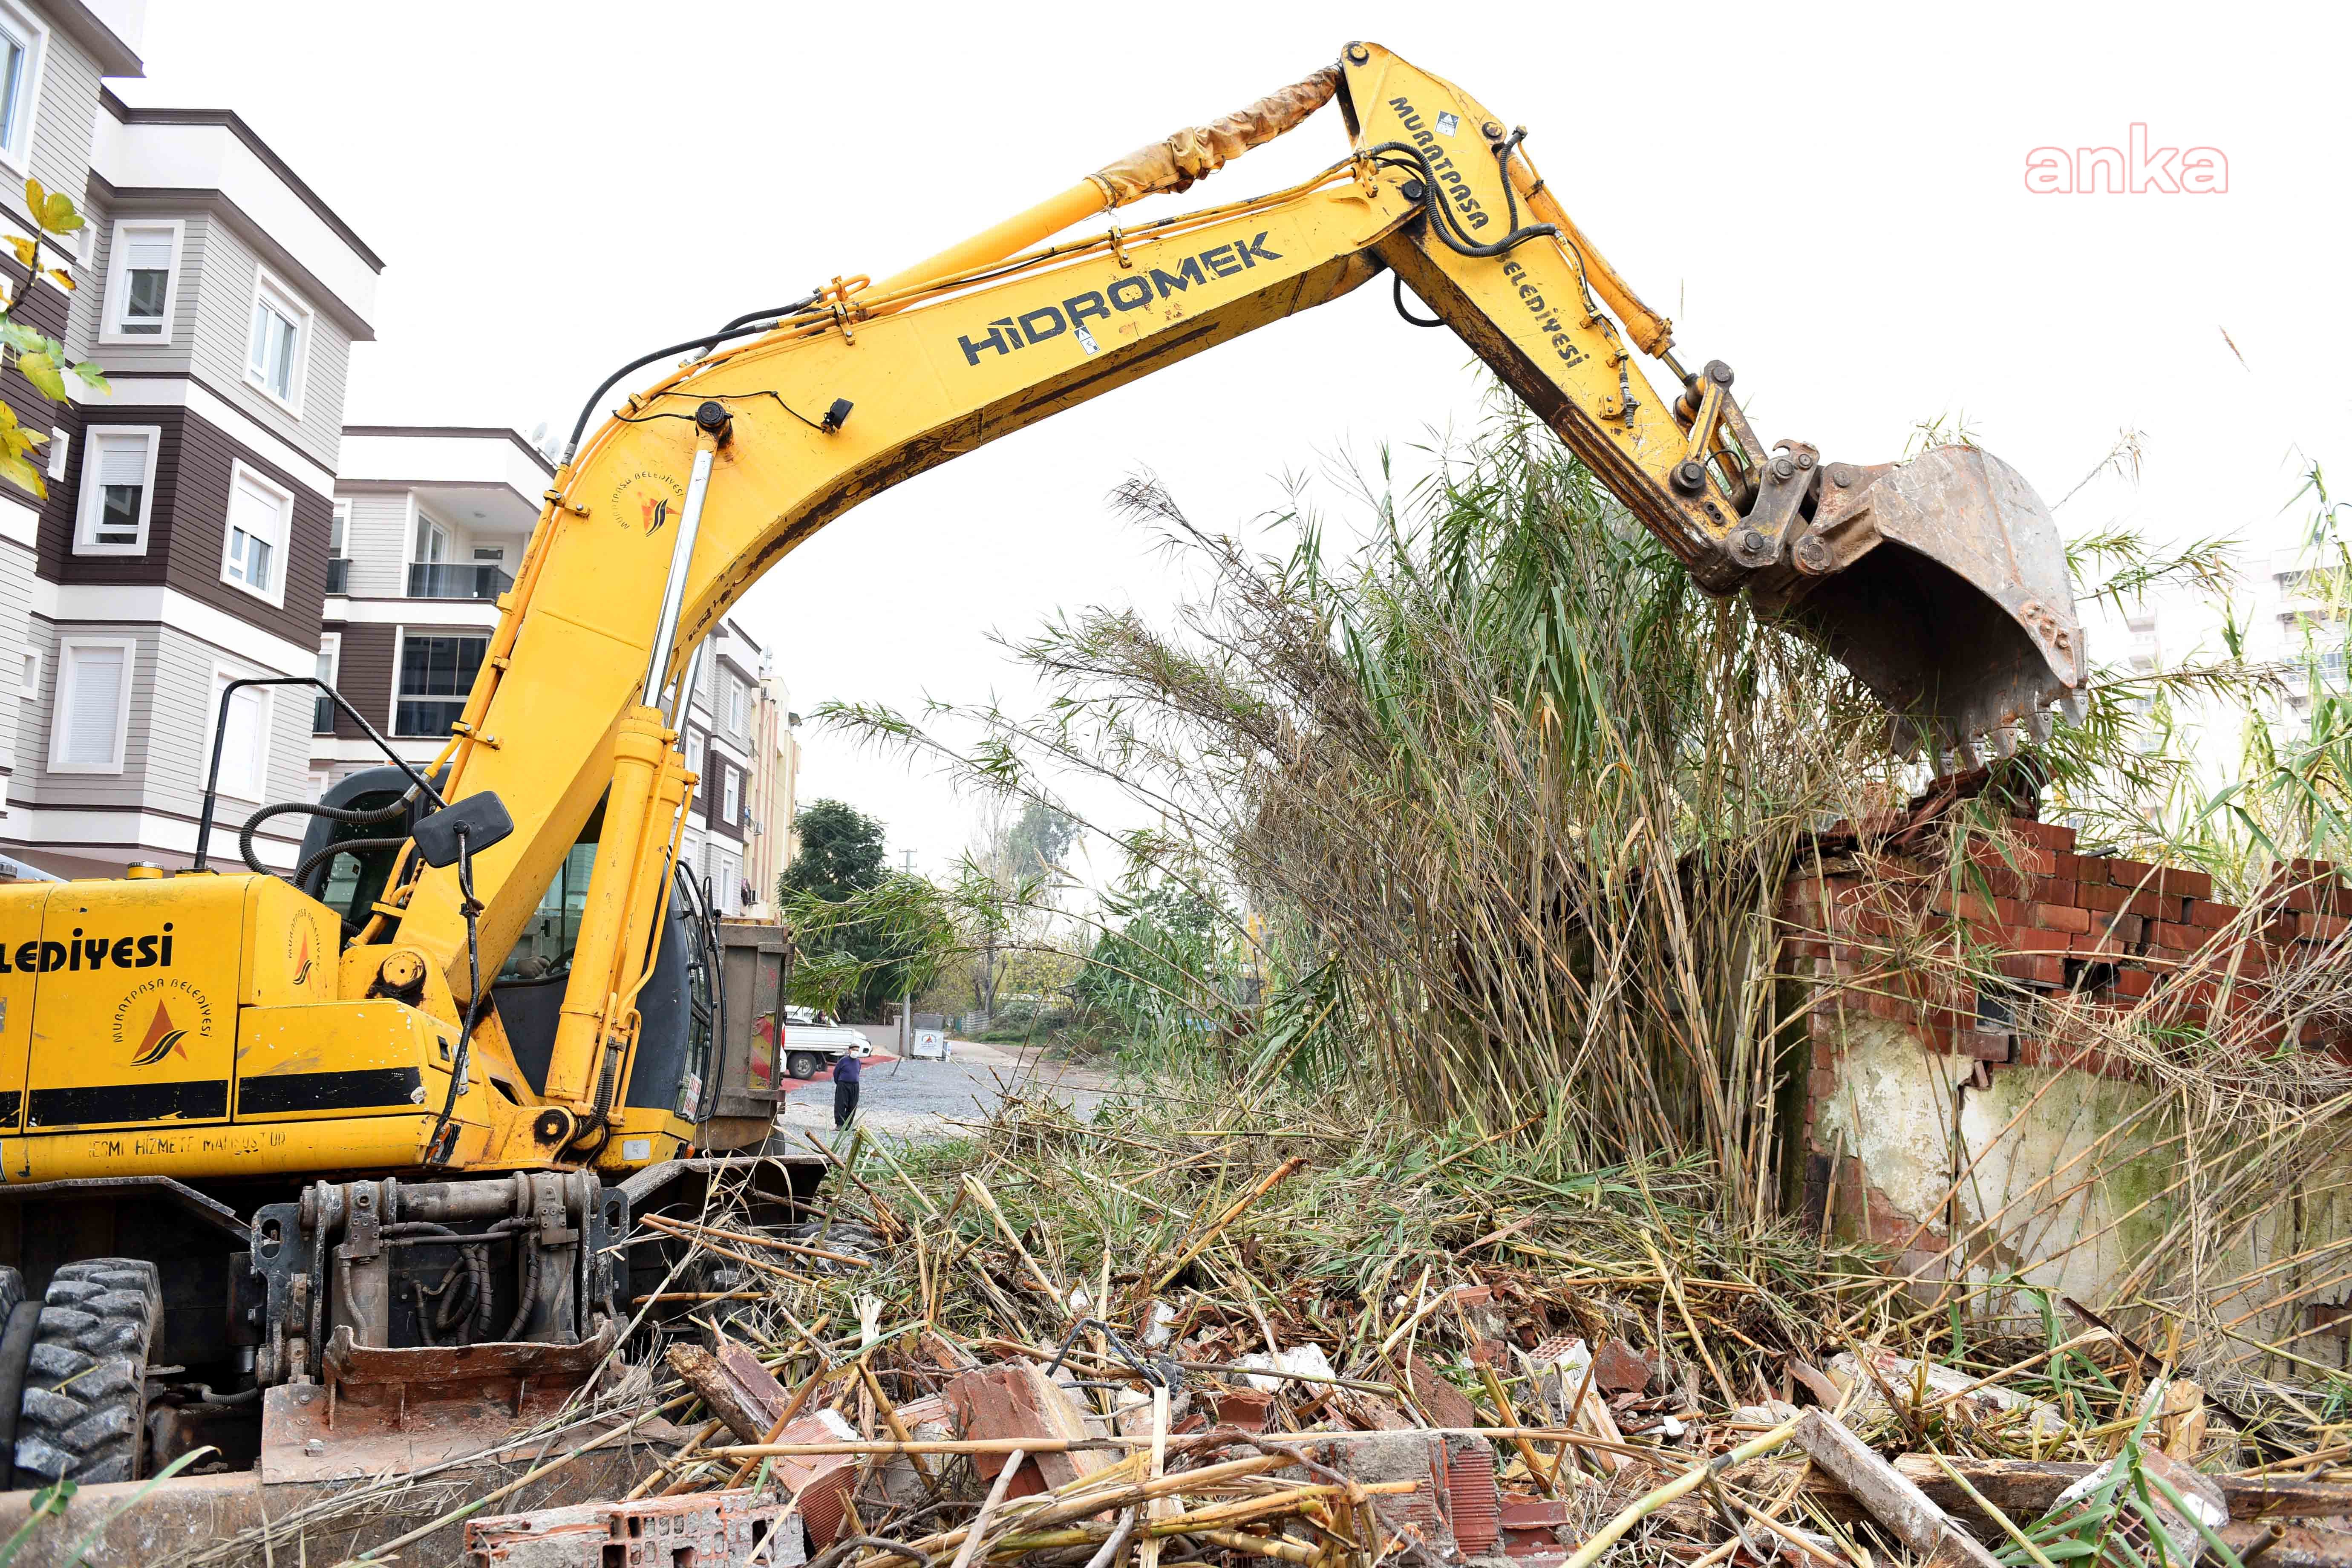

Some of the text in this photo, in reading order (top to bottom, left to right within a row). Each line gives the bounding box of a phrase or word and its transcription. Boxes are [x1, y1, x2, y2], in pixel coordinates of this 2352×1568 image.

[1388, 97, 1489, 230] MURATPAŞA
[112, 978, 213, 1043] MURATPAŞA BELEDİYESİ
